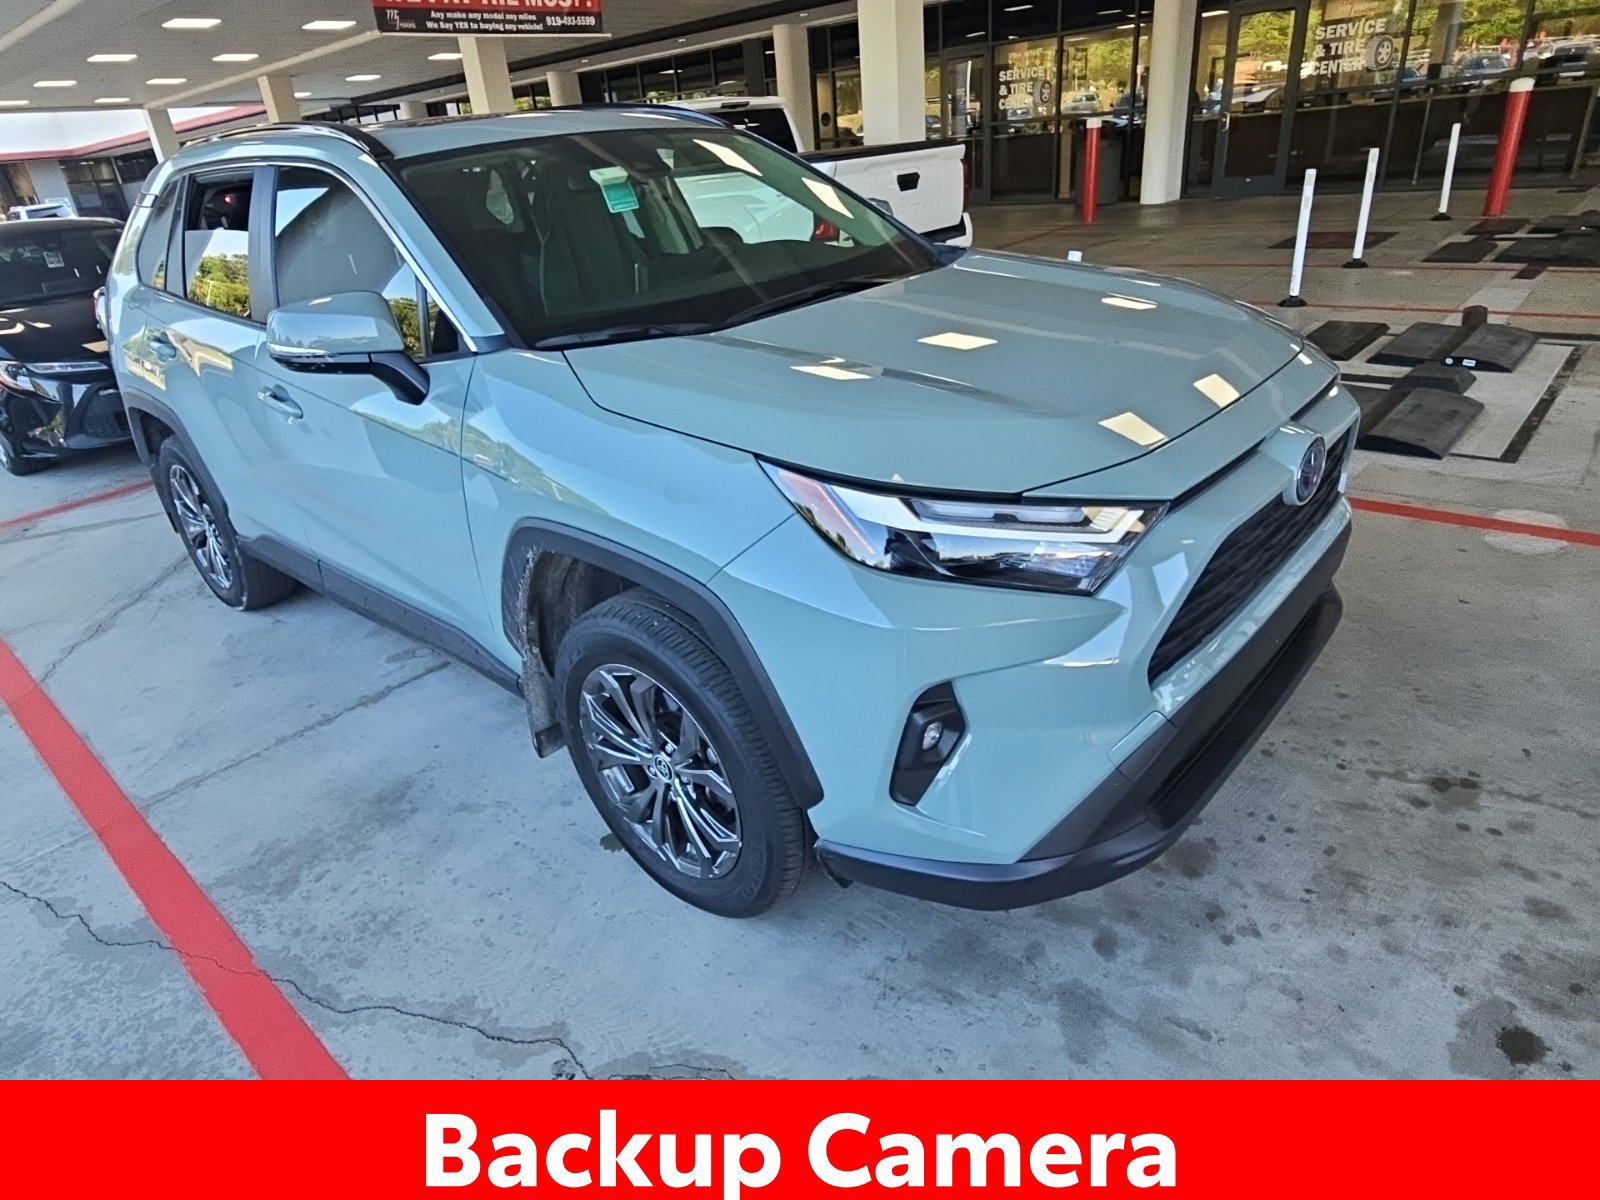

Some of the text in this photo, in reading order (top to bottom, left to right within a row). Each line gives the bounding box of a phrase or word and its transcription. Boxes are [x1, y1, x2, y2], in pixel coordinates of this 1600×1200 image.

[431, 10, 444, 20] Any
[468, 12, 481, 20] any
[426, 21, 438, 29] We
[439, 21, 453, 30] Say
[479, 22, 504, 31] buying
[1315, 18, 1387, 40] SERVICE
[1315, 38, 1366, 57] & TIRE
[999, 66, 1046, 81] SERVICE
[1312, 58, 1364, 76] CENTER
[999, 81, 1033, 96] & TIRE
